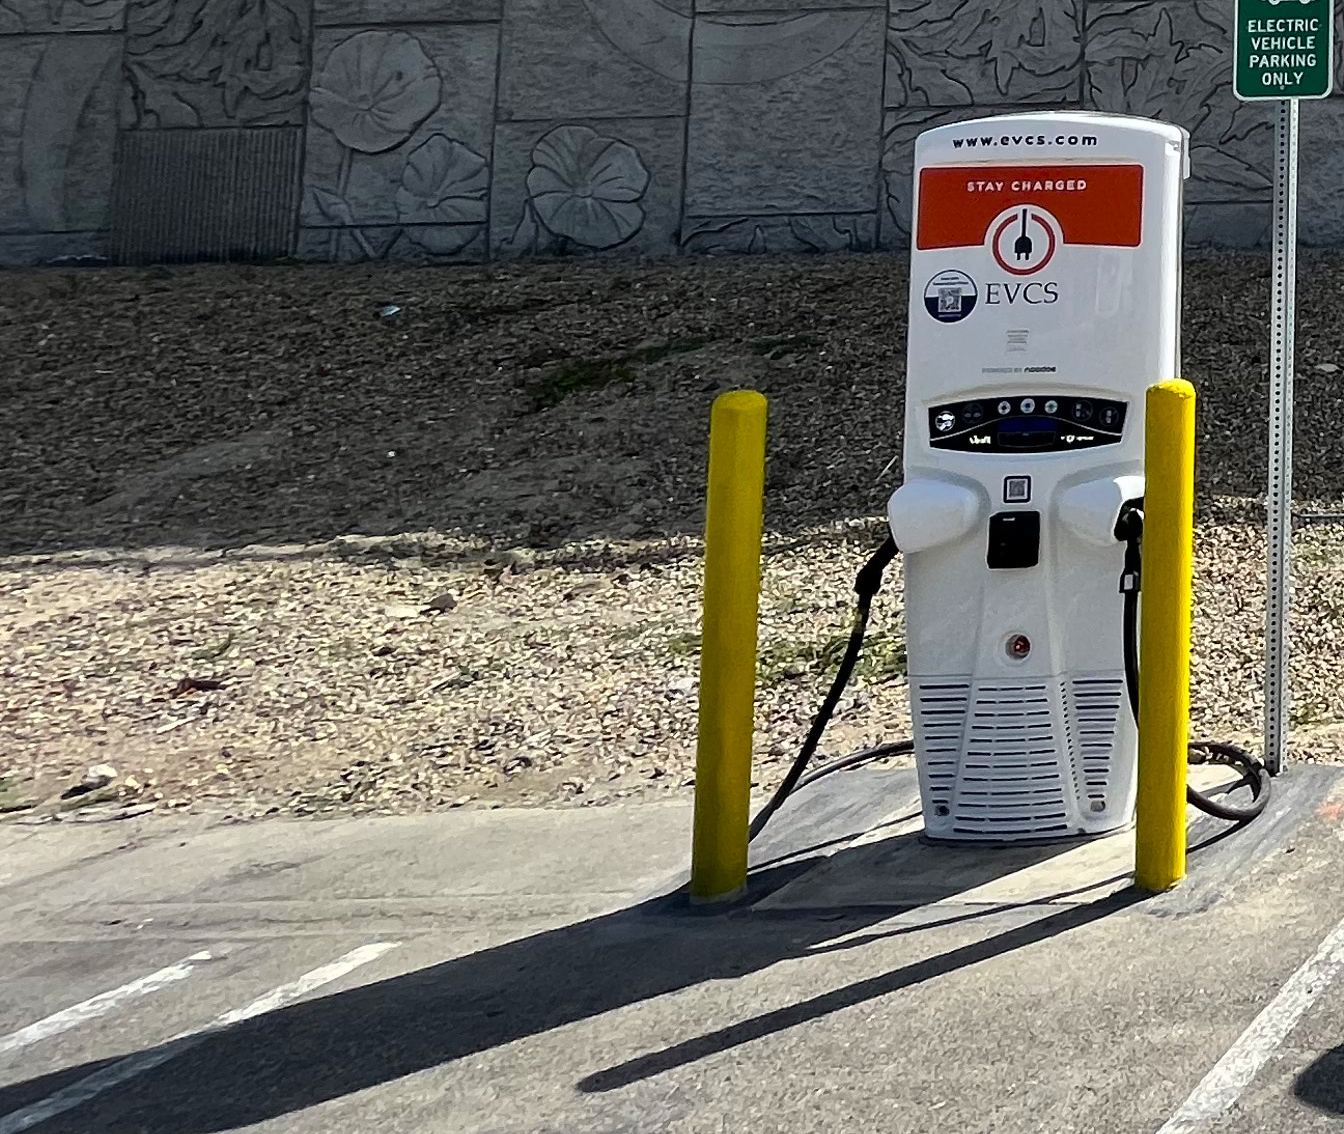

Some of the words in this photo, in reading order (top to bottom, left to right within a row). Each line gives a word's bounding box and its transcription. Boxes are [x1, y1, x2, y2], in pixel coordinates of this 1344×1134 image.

[1247, 18, 1319, 33] ELECTRIC
[1251, 35, 1316, 50] VEHICLE
[1249, 53, 1317, 68] PARKING
[1261, 71, 1304, 86] ONLY
[952, 133, 1098, 149] www.evcs.com
[967, 180, 1004, 192] STAY
[1011, 179, 1087, 191] CHARGED
[984, 281, 1059, 305] EVCS
